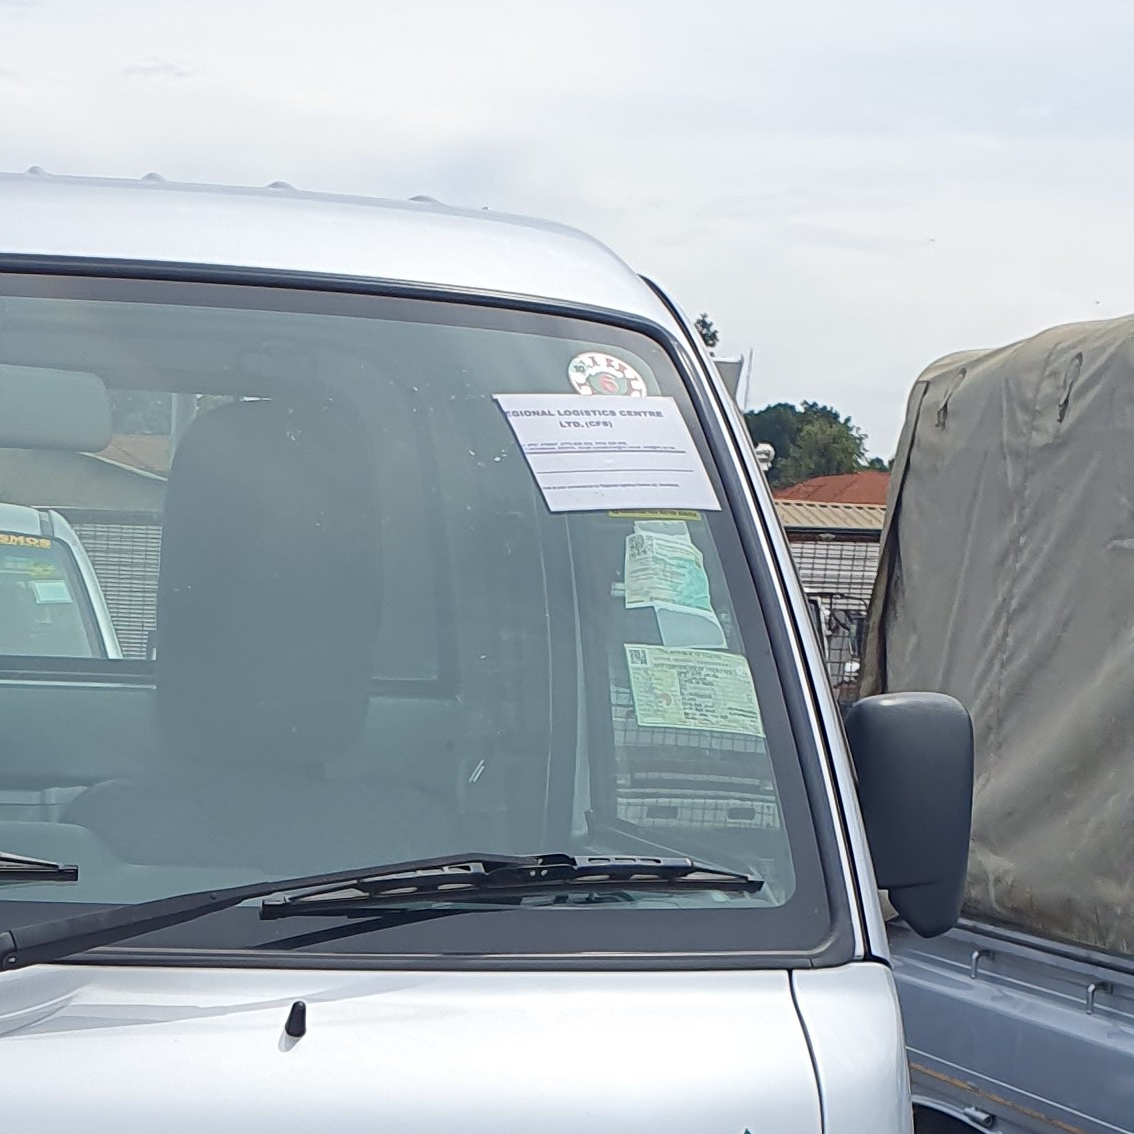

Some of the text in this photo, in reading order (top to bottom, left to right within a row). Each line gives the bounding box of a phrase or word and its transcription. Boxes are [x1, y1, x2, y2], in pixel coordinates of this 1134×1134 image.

[557, 409, 617, 417] LOGISTICS
[619, 410, 664, 418] CENTRE
[559, 420, 585, 428] LTD.
